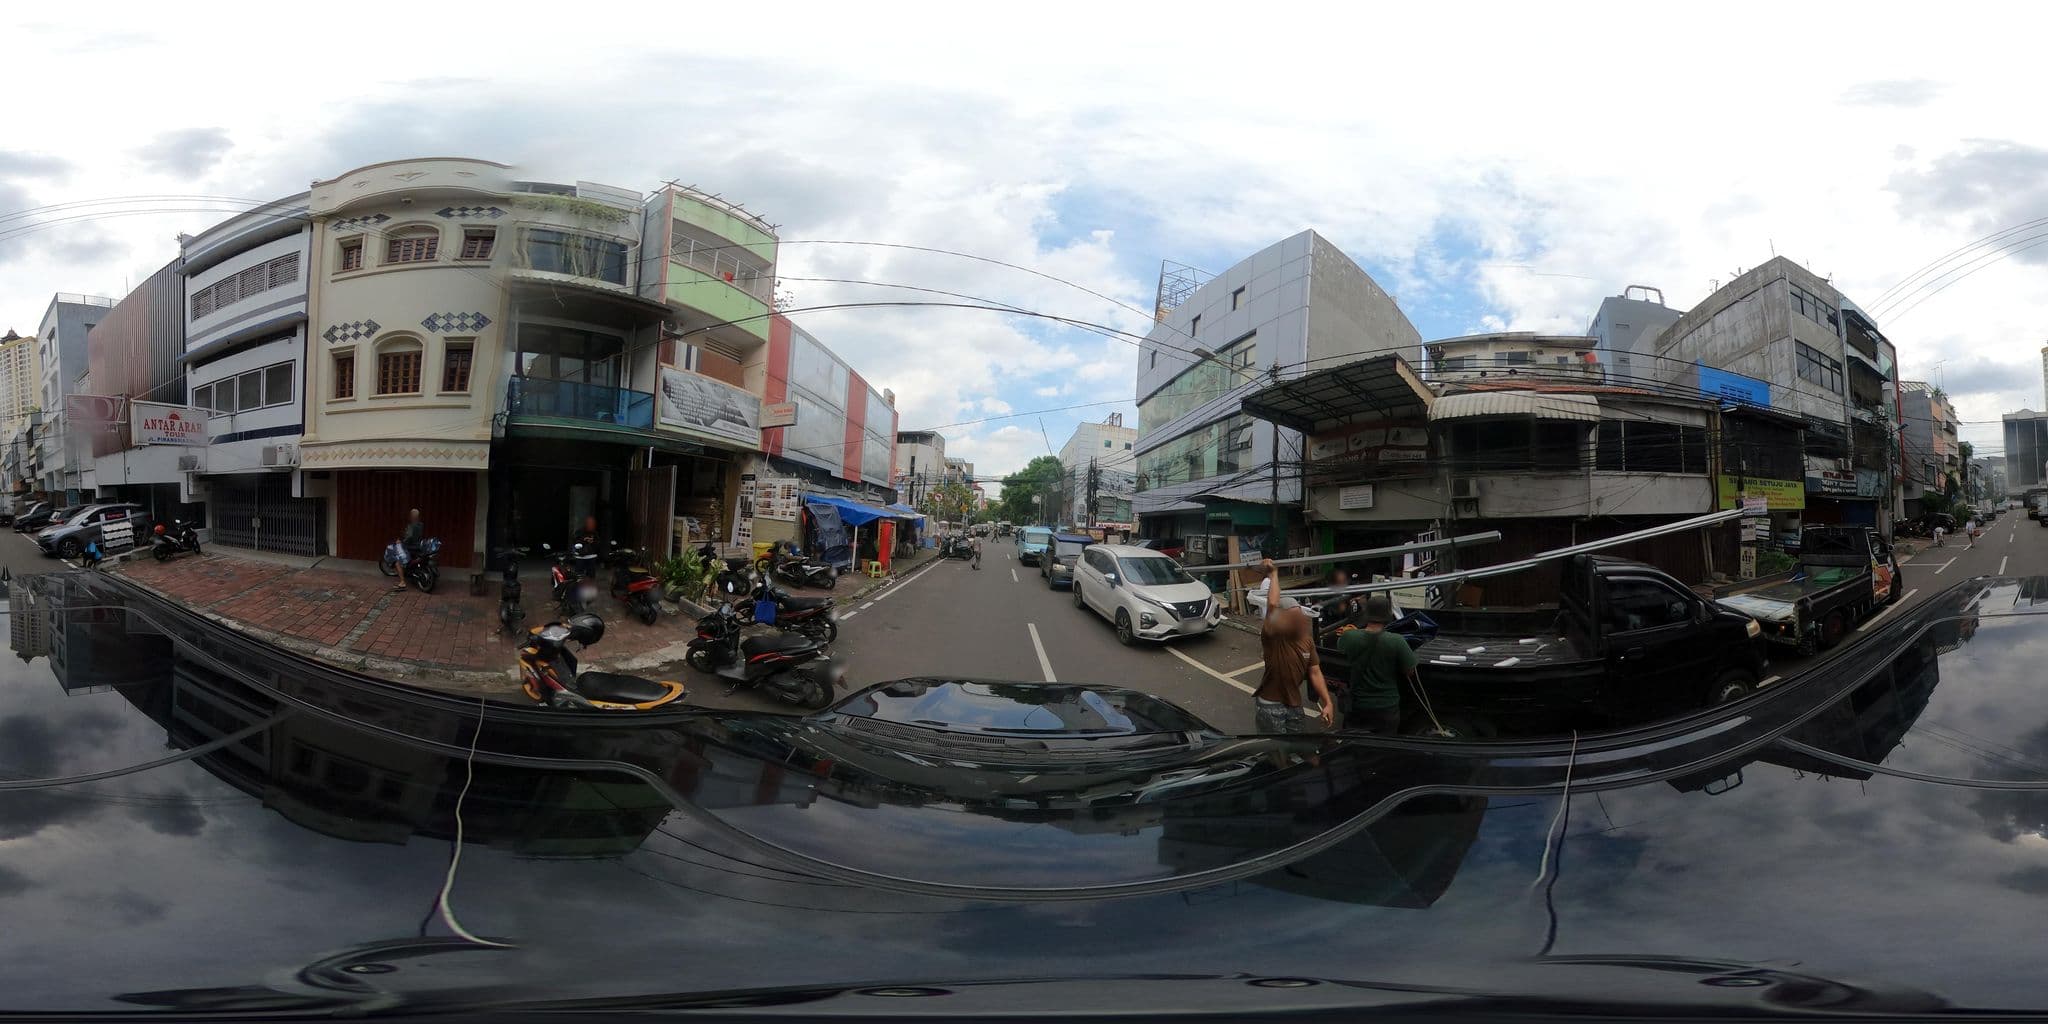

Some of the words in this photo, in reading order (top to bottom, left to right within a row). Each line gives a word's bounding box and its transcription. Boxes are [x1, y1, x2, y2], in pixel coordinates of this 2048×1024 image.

[144, 419, 176, 431] ANTAR
[178, 421, 202, 433] ARAH
[1760, 480, 1783, 488] SETUJU
